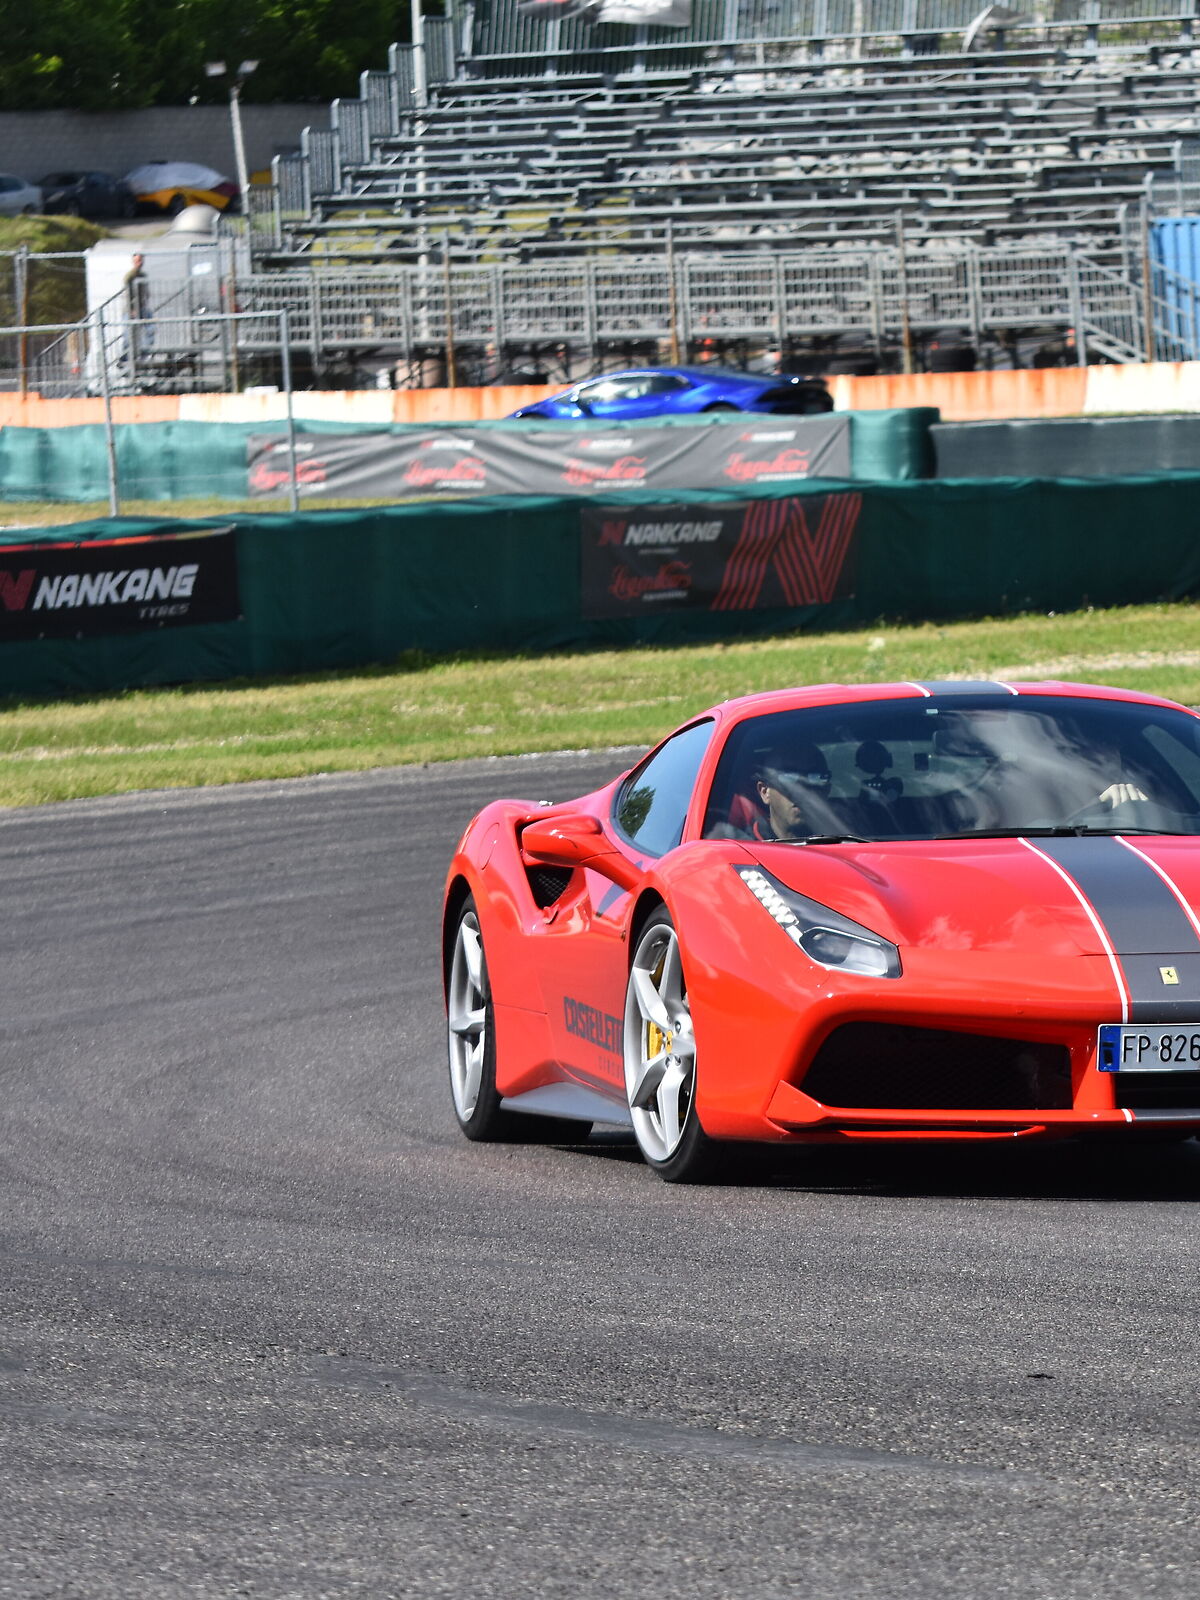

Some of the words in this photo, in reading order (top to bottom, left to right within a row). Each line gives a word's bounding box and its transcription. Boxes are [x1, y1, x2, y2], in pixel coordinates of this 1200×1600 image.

[624, 521, 723, 545] NANKANG
[31, 564, 199, 611] NANKANG
[139, 602, 190, 619] TYRES
[1122, 1033, 1151, 1063] FP
